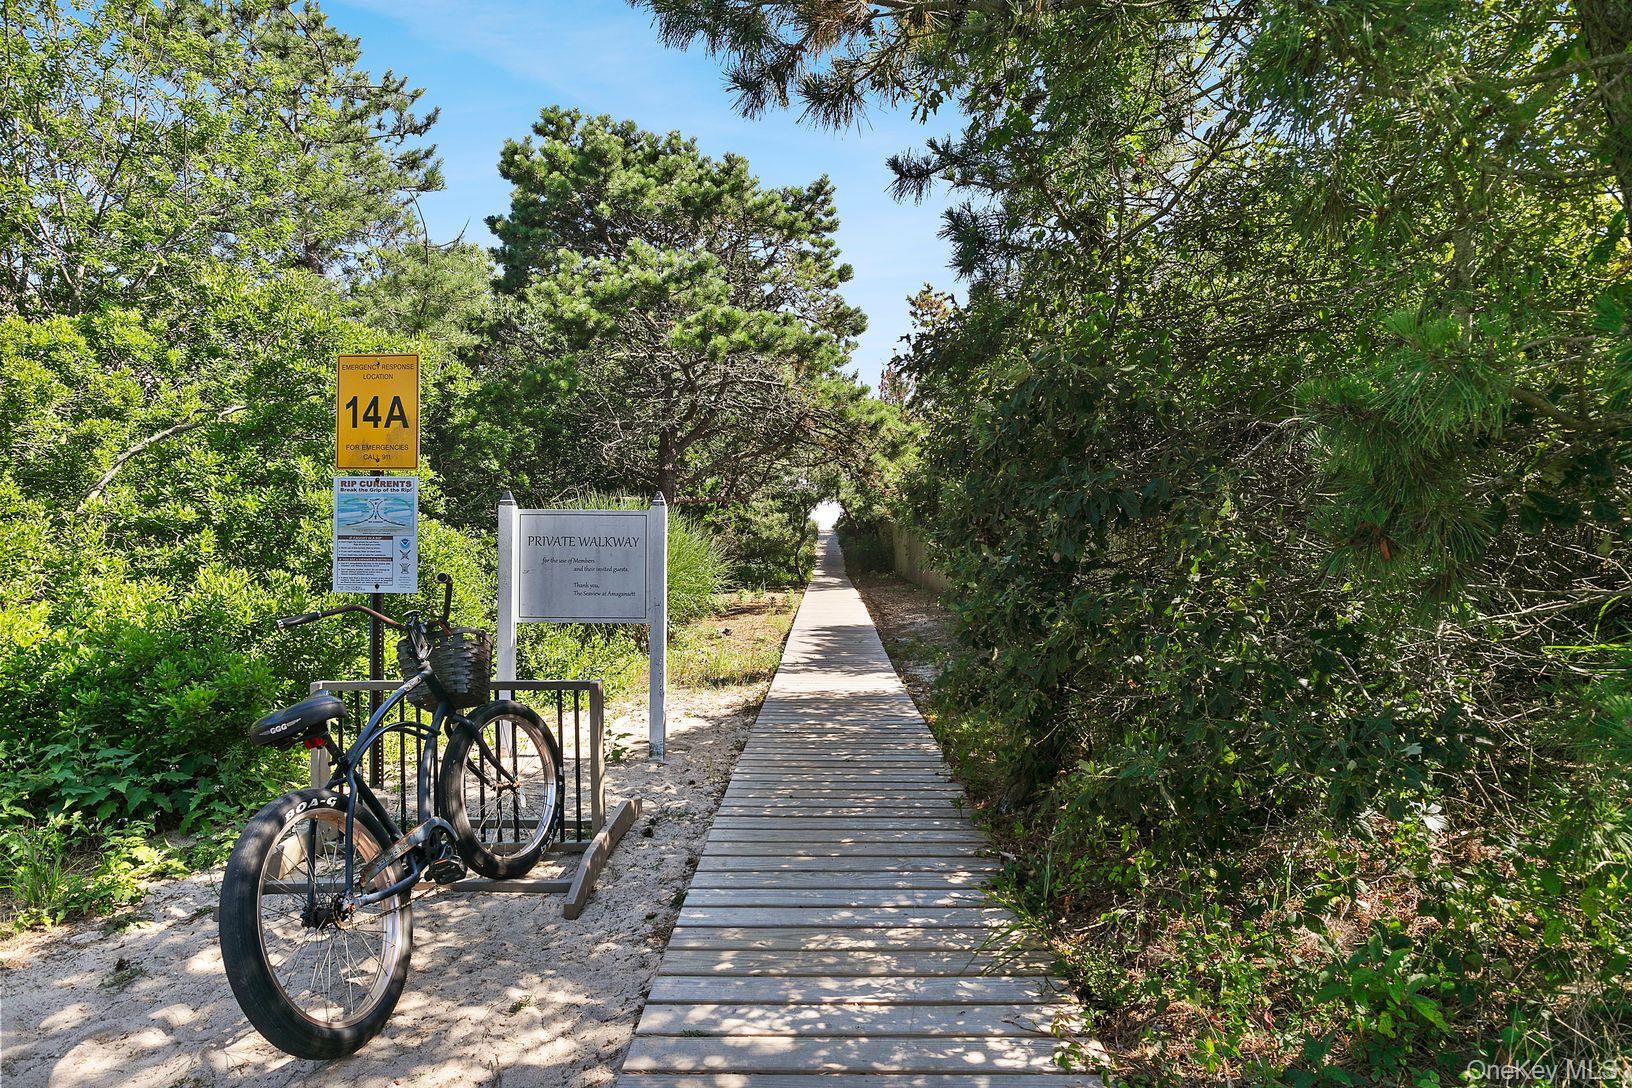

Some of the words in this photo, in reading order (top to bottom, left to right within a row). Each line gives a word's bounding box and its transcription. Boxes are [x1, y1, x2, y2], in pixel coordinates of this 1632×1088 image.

[345, 395, 409, 428] 14A
[528, 535, 576, 547] PRIVATE
[578, 536, 640, 548] WALKWAY
[541, 557, 550, 565] for
[567, 557, 574, 565] of
[269, 722, 288, 735] GGG
[284, 796, 338, 821] BOA-G
